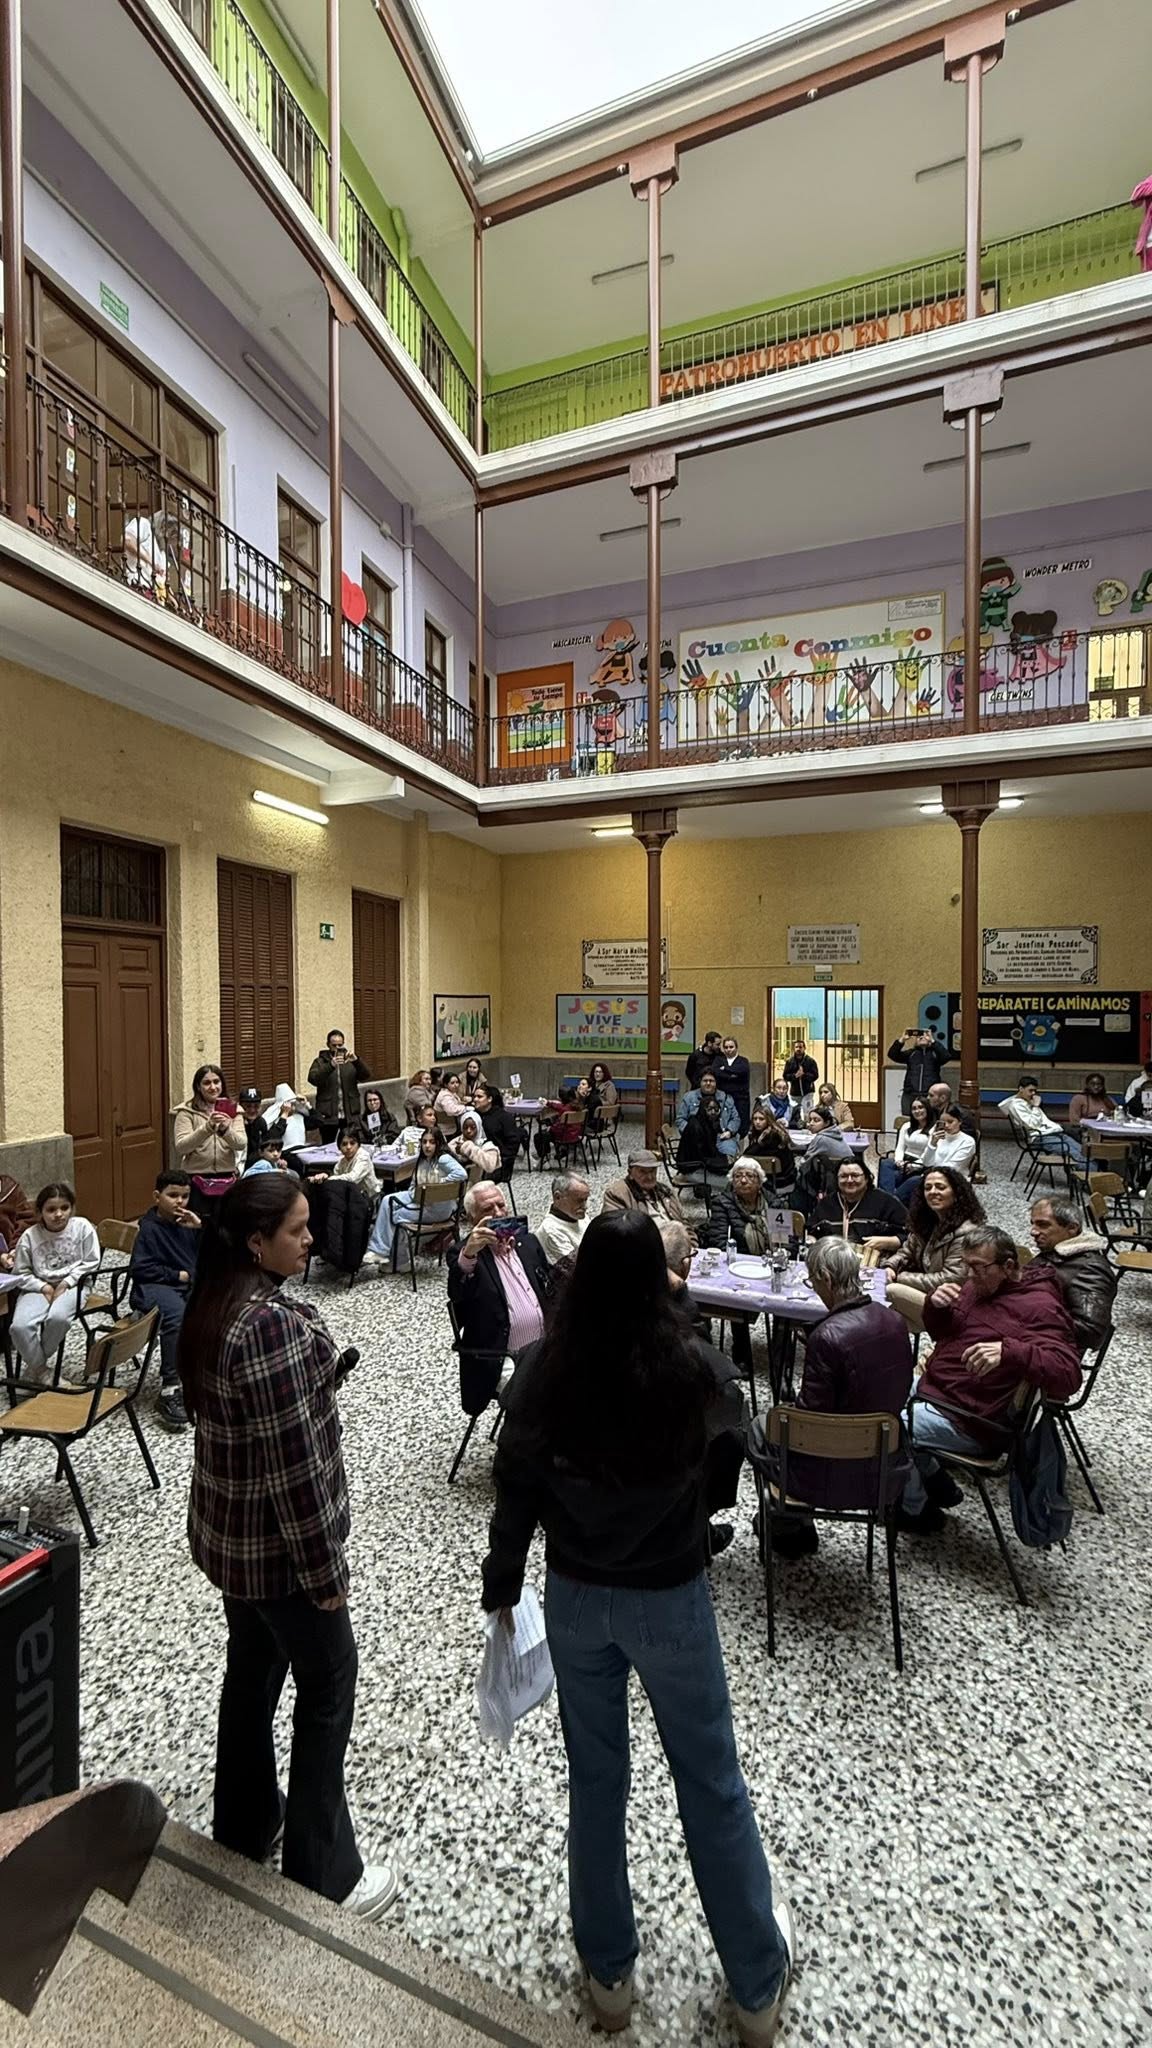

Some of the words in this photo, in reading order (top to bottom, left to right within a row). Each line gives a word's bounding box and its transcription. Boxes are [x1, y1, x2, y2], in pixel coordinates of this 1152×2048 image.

[660, 333, 840, 395] PATROHUERTO
[1025, 564, 1058, 577] WONDER
[1062, 559, 1090, 572] METRO
[688, 631, 790, 658] Cuenta
[794, 627, 932, 657] Conmigo
[996, 941, 1009, 949] Sor
[1014, 940, 1045, 949] Josefina
[1048, 939, 1083, 948] Pescador
[585, 1014, 622, 1026] VIVE
[774, 1212, 785, 1225] 4
